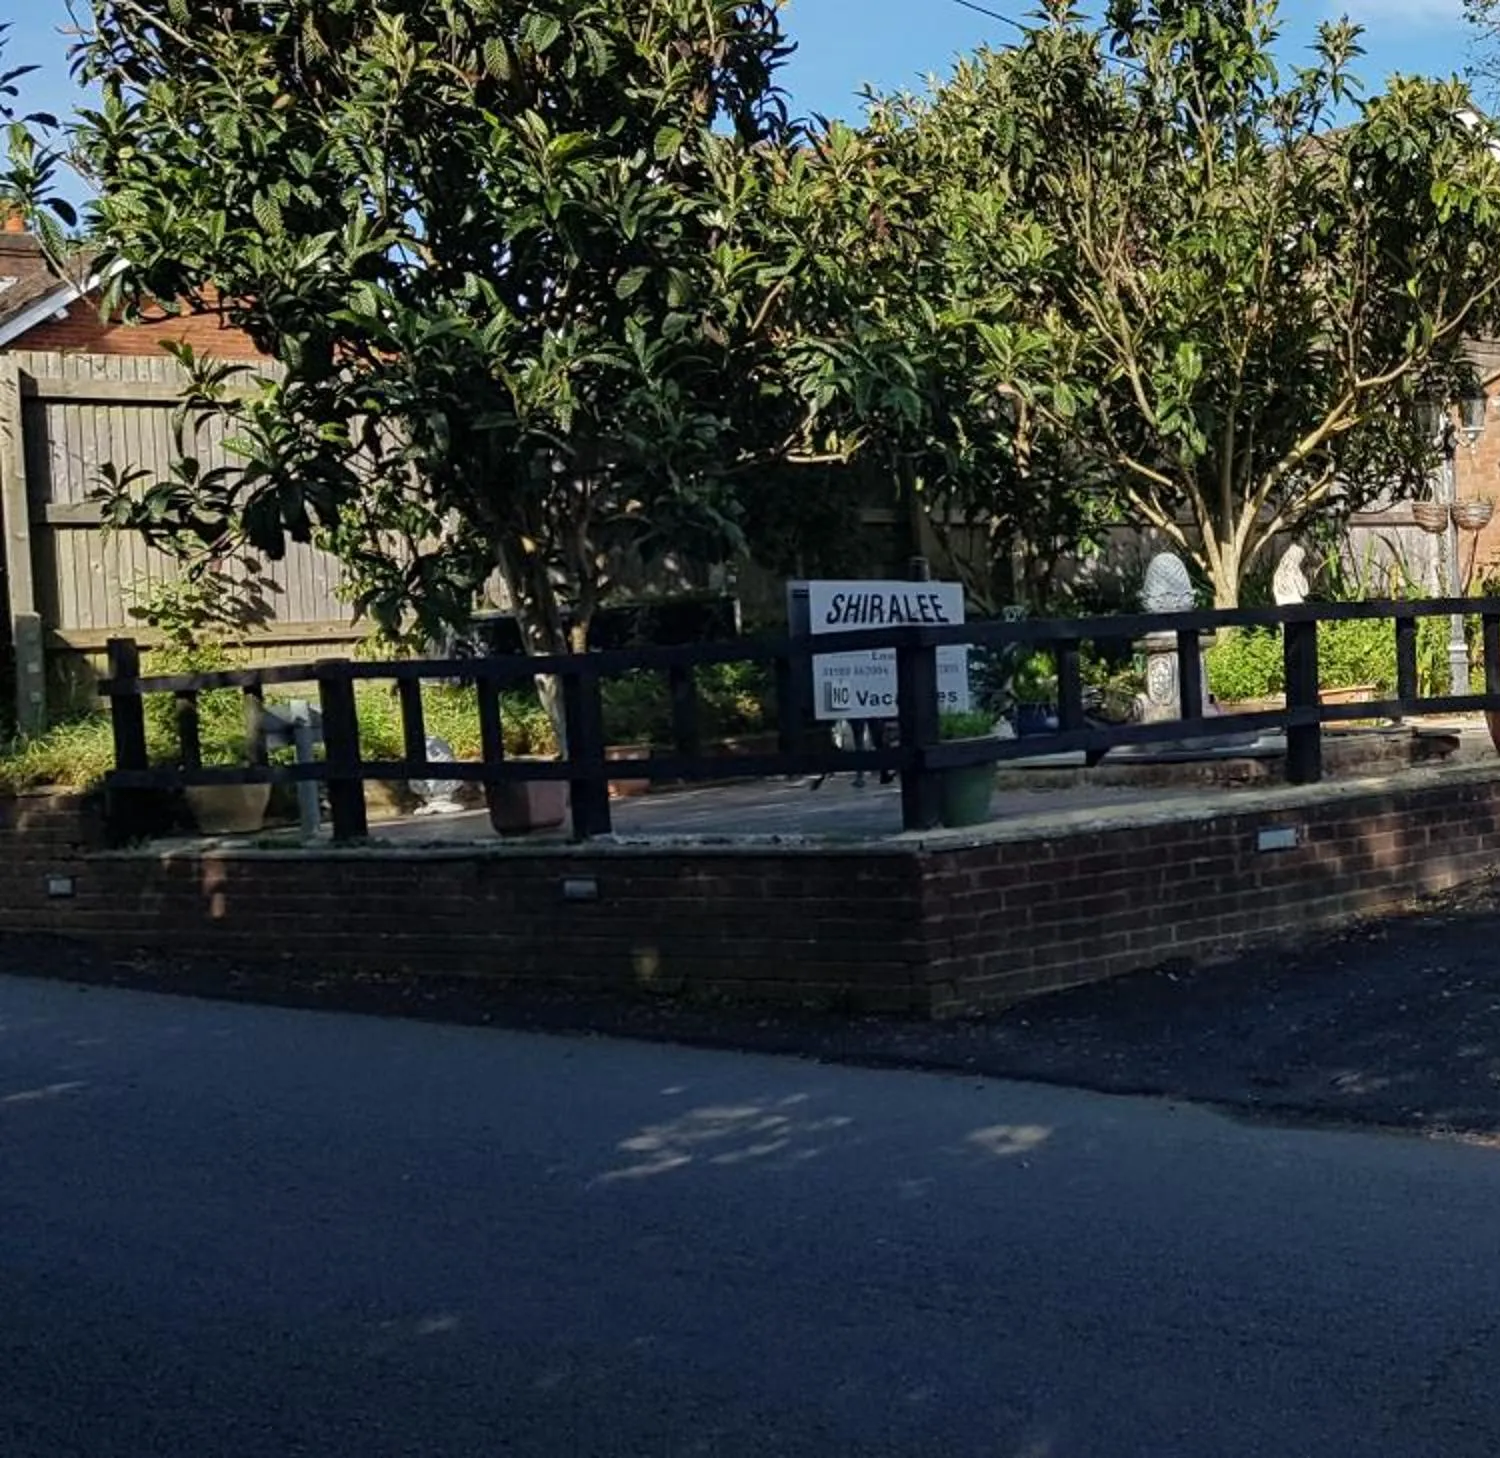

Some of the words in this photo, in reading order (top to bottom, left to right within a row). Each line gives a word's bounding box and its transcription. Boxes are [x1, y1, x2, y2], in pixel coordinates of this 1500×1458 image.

[826, 593, 949, 625] SHIRALEE
[833, 687, 849, 705] NO
[856, 690, 958, 707] Vaces
